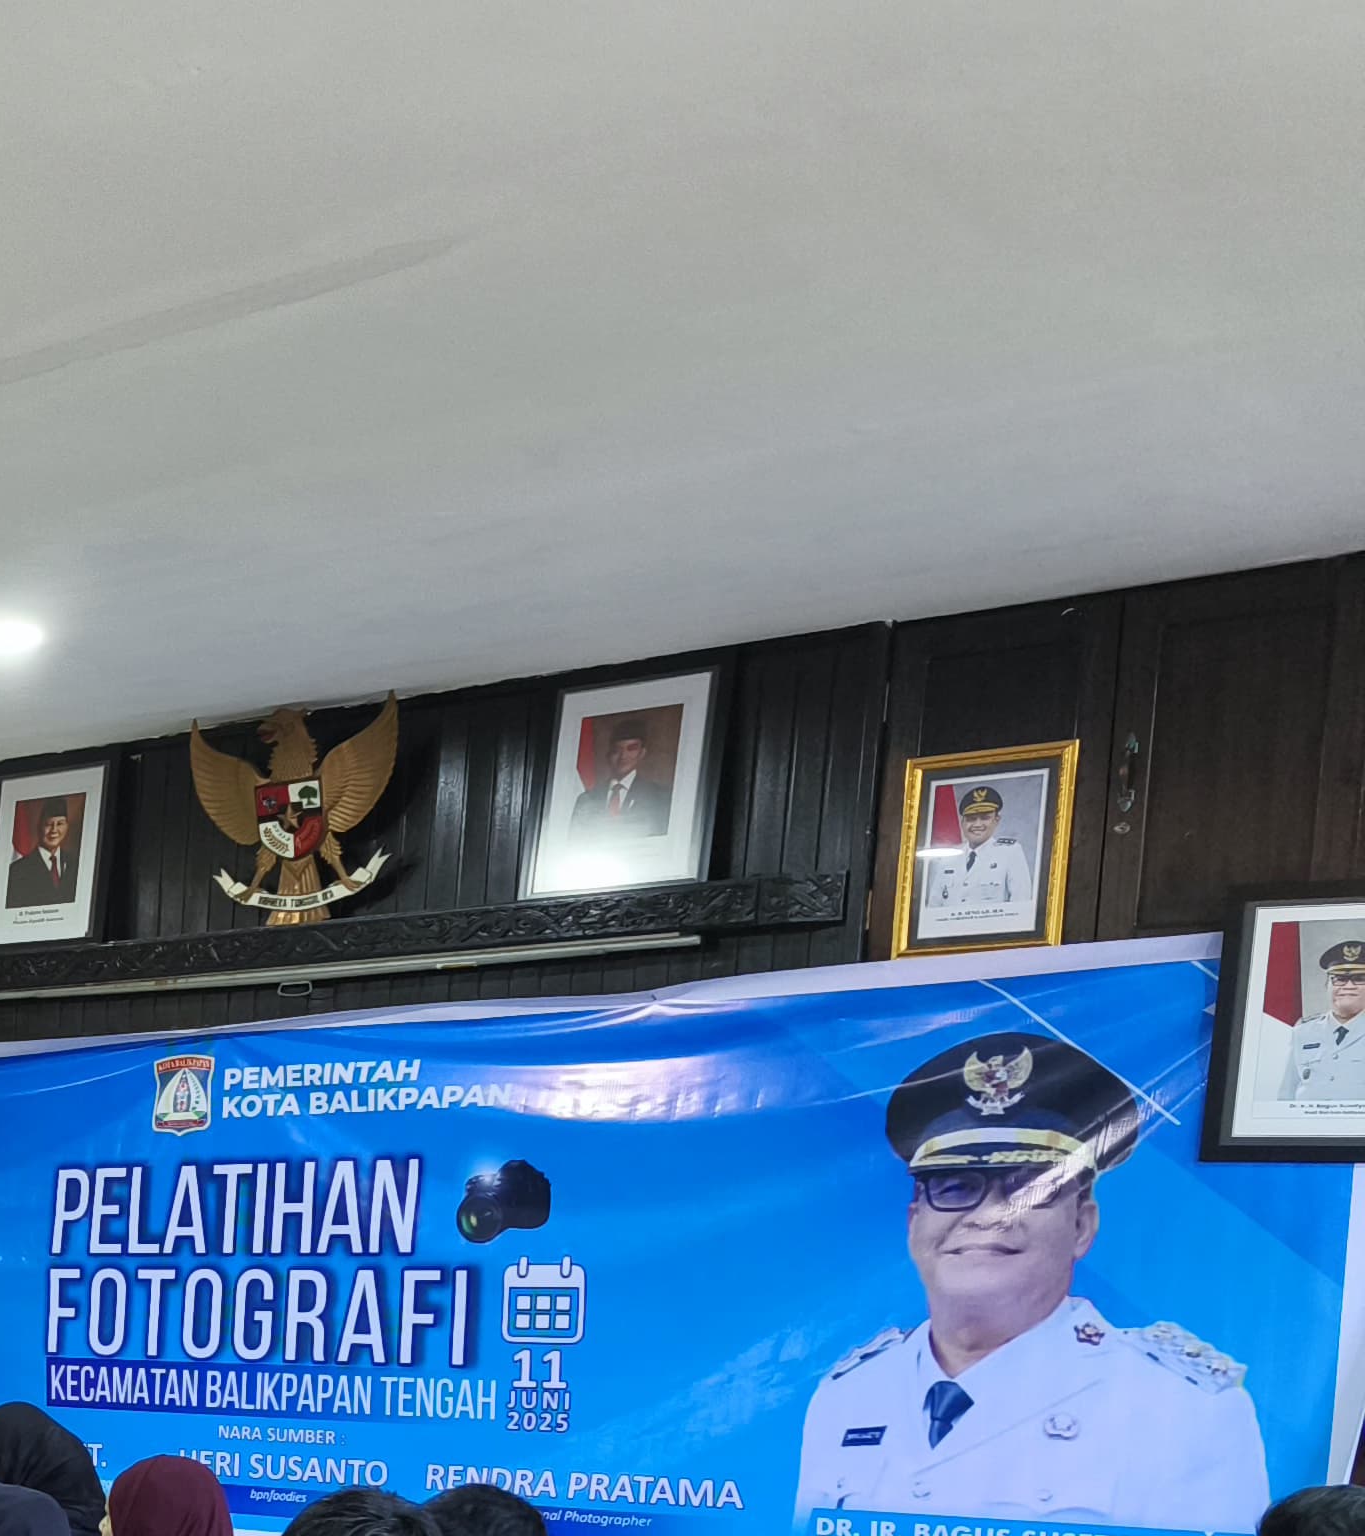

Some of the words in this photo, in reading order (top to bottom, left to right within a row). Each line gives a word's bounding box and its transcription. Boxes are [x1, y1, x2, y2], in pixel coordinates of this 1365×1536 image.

[223, 1059, 421, 1090] PEMERINTAH
[222, 1093, 302, 1118] KOTA
[309, 1084, 511, 1114] BALIKPAPAN
[50, 1157, 420, 1256] PELATIHAN
[46, 1267, 468, 1366] FOTOGRAFI
[512, 1348, 568, 1389] 11
[50, 1365, 199, 1403] KECAMATAN
[206, 1370, 372, 1415] BALIKPAPAN
[380, 1376, 497, 1420] TENGAH
[506, 1390, 570, 1411] JUNI
[218, 1425, 262, 1440] NARA
[267, 1428, 336, 1445] SUMBER
[506, 1411, 570, 1433] 2025
[84, 1443, 108, 1467] T.
[248, 1453, 388, 1486] SUSANTO
[250, 1488, 308, 1503] bpnfoodies
[426, 1464, 557, 1498] RENDRA
[568, 1472, 745, 1510] PRATAMA
[564, 1510, 653, 1527] Photographer
